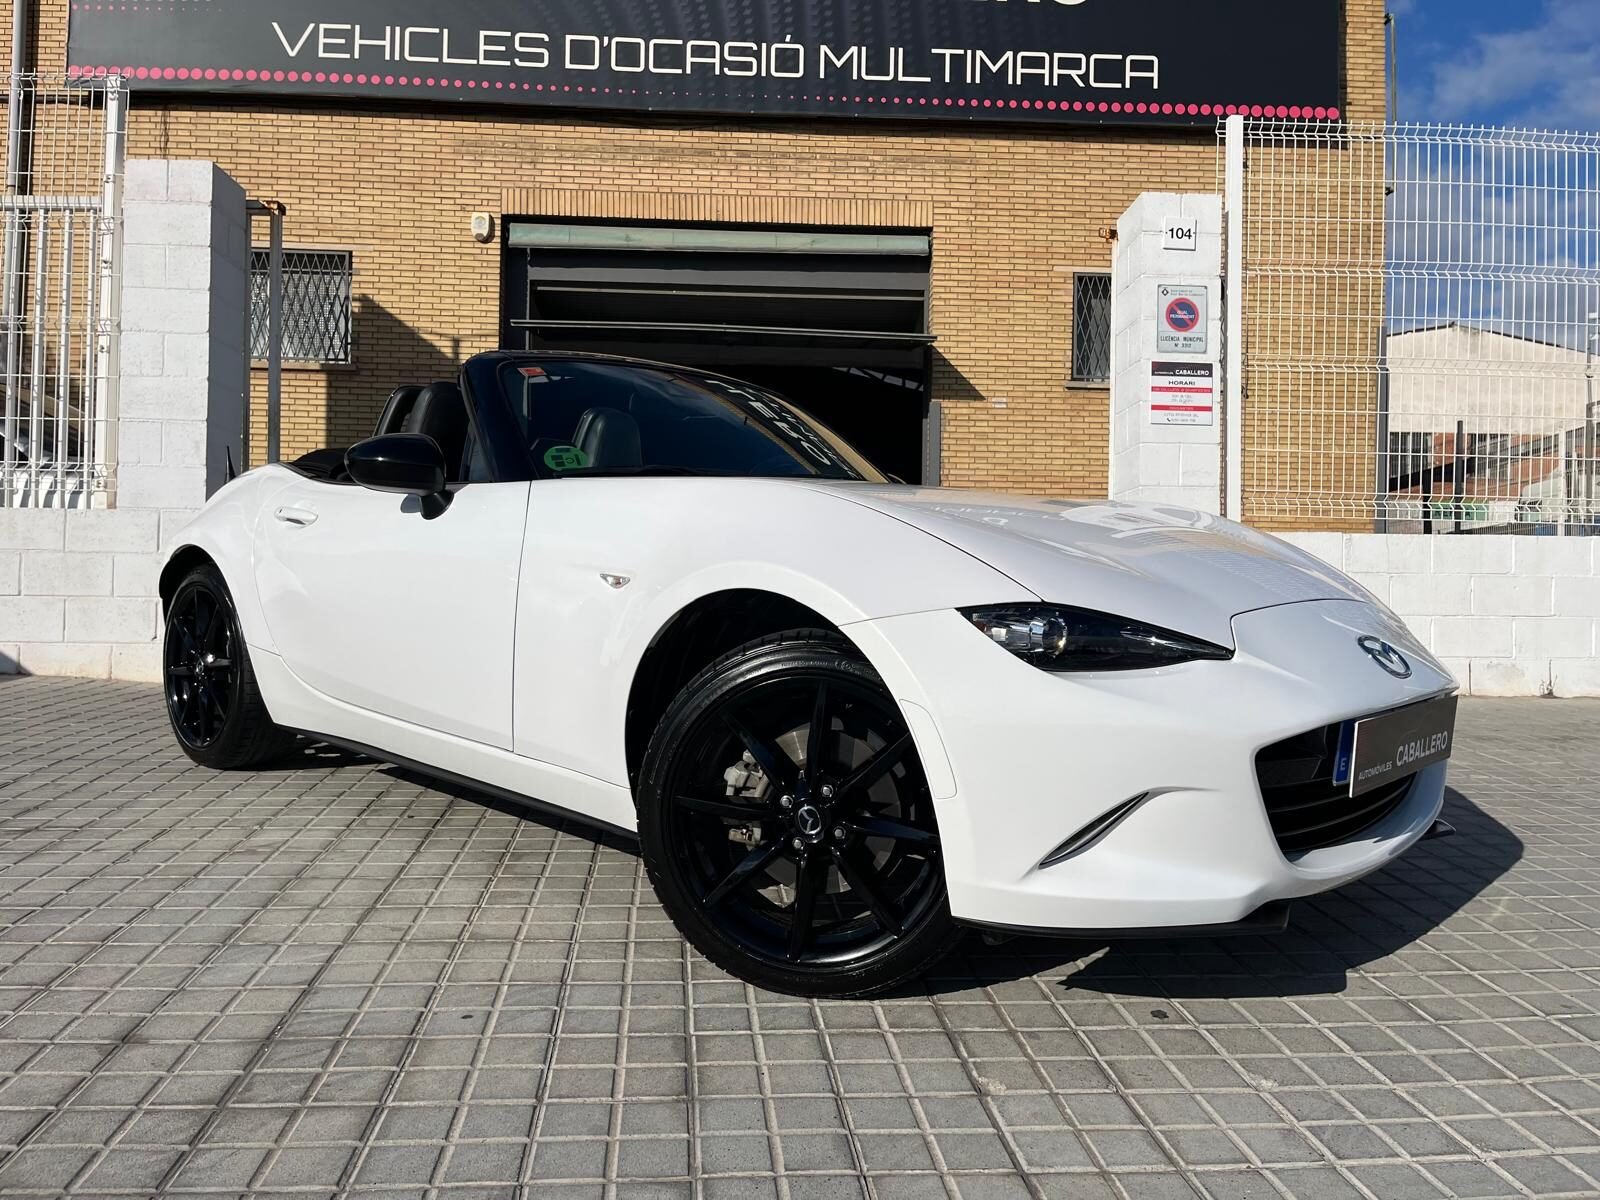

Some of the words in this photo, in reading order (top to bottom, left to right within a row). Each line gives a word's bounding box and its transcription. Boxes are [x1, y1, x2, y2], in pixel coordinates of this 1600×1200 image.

[271, 21, 550, 69] VEHICLES
[564, 34, 805, 79] D'OCASIÓ
[819, 44, 1159, 89] MULTIMARCA
[1168, 227, 1192, 240] 104
[1395, 730, 1448, 767] CABALLERO
